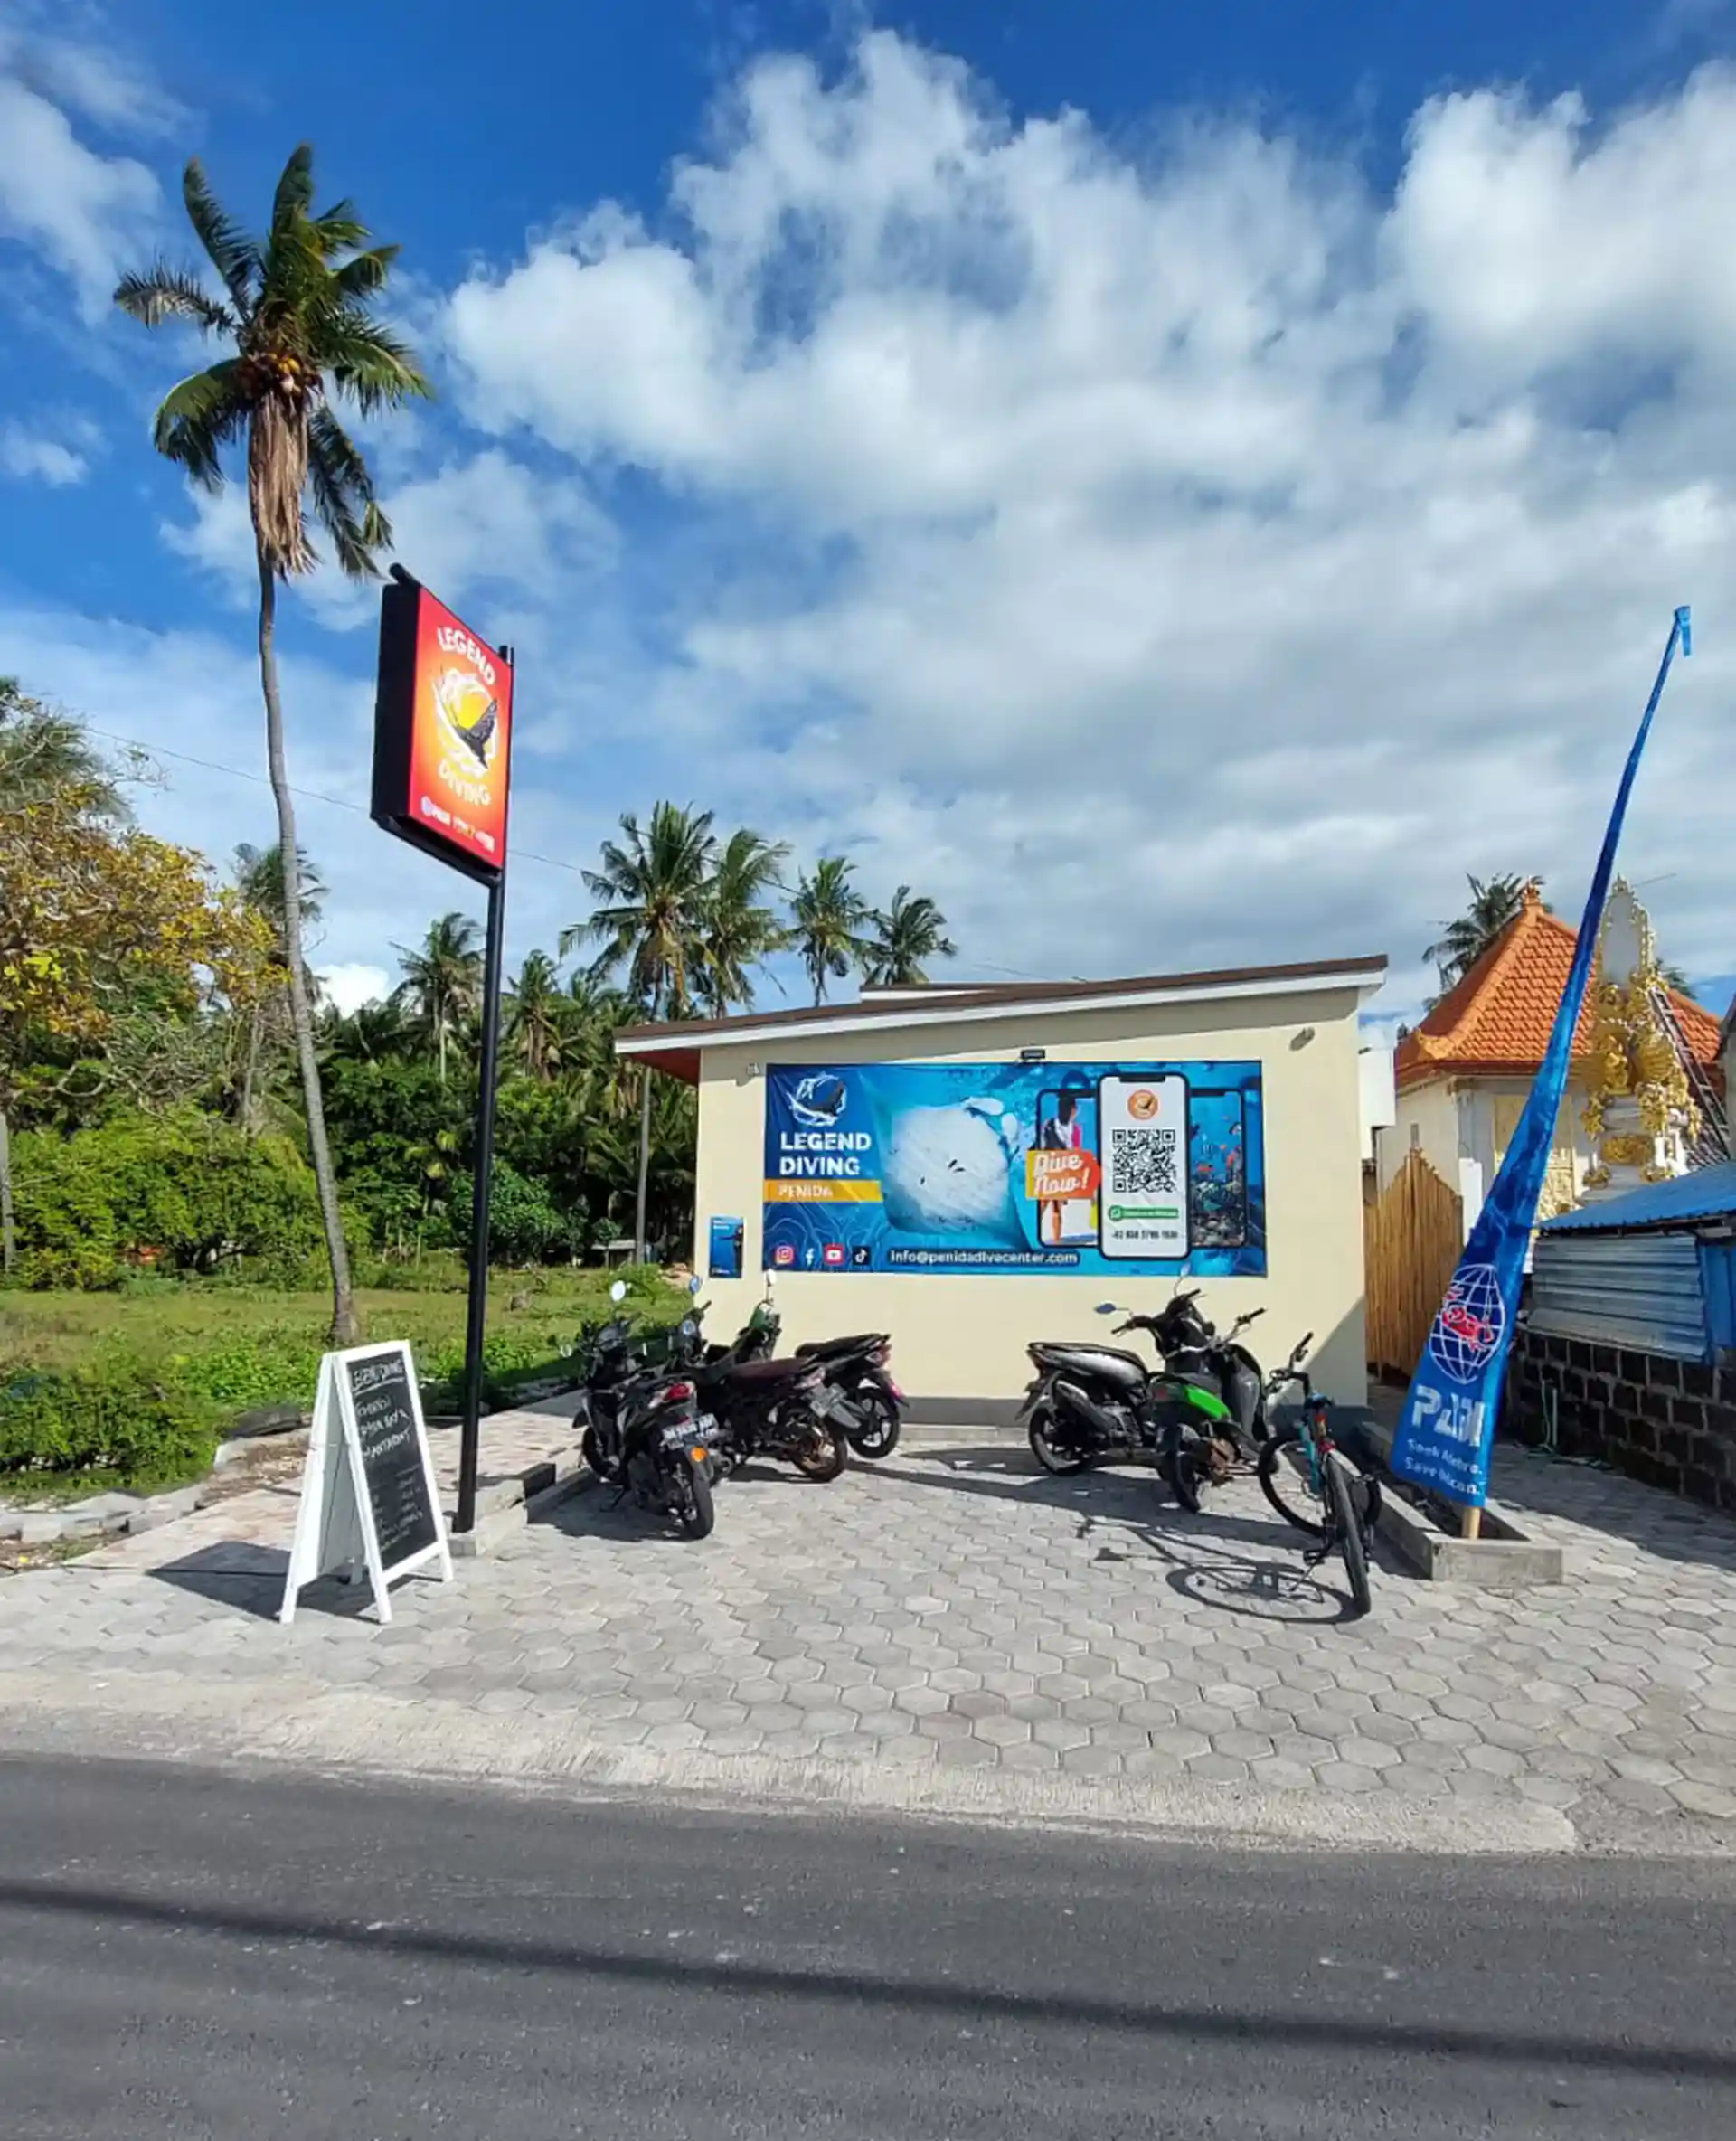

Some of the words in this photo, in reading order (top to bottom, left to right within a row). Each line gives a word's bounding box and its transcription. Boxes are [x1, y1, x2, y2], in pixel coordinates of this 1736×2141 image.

[438, 626, 495, 685] LEGEND
[438, 759, 492, 806] DIVING
[779, 1132, 872, 1150] LEGEND
[779, 1156, 861, 1175] DIVING
